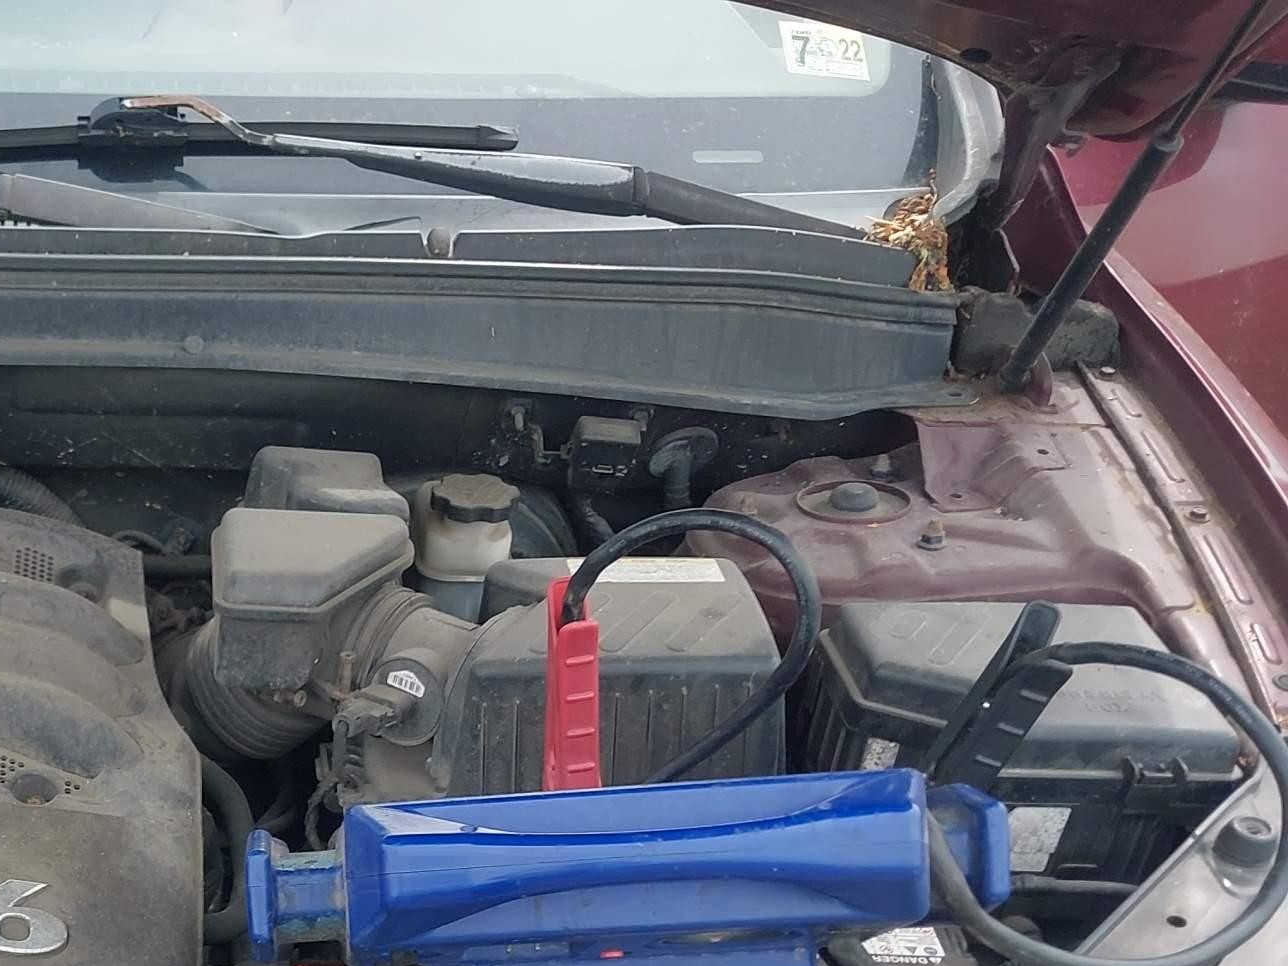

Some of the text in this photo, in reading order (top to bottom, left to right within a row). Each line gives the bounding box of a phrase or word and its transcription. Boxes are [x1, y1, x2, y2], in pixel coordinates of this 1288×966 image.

[792, 35, 809, 64] 7
[839, 38, 863, 62] 22
[872, 955, 928, 964] DANGER
